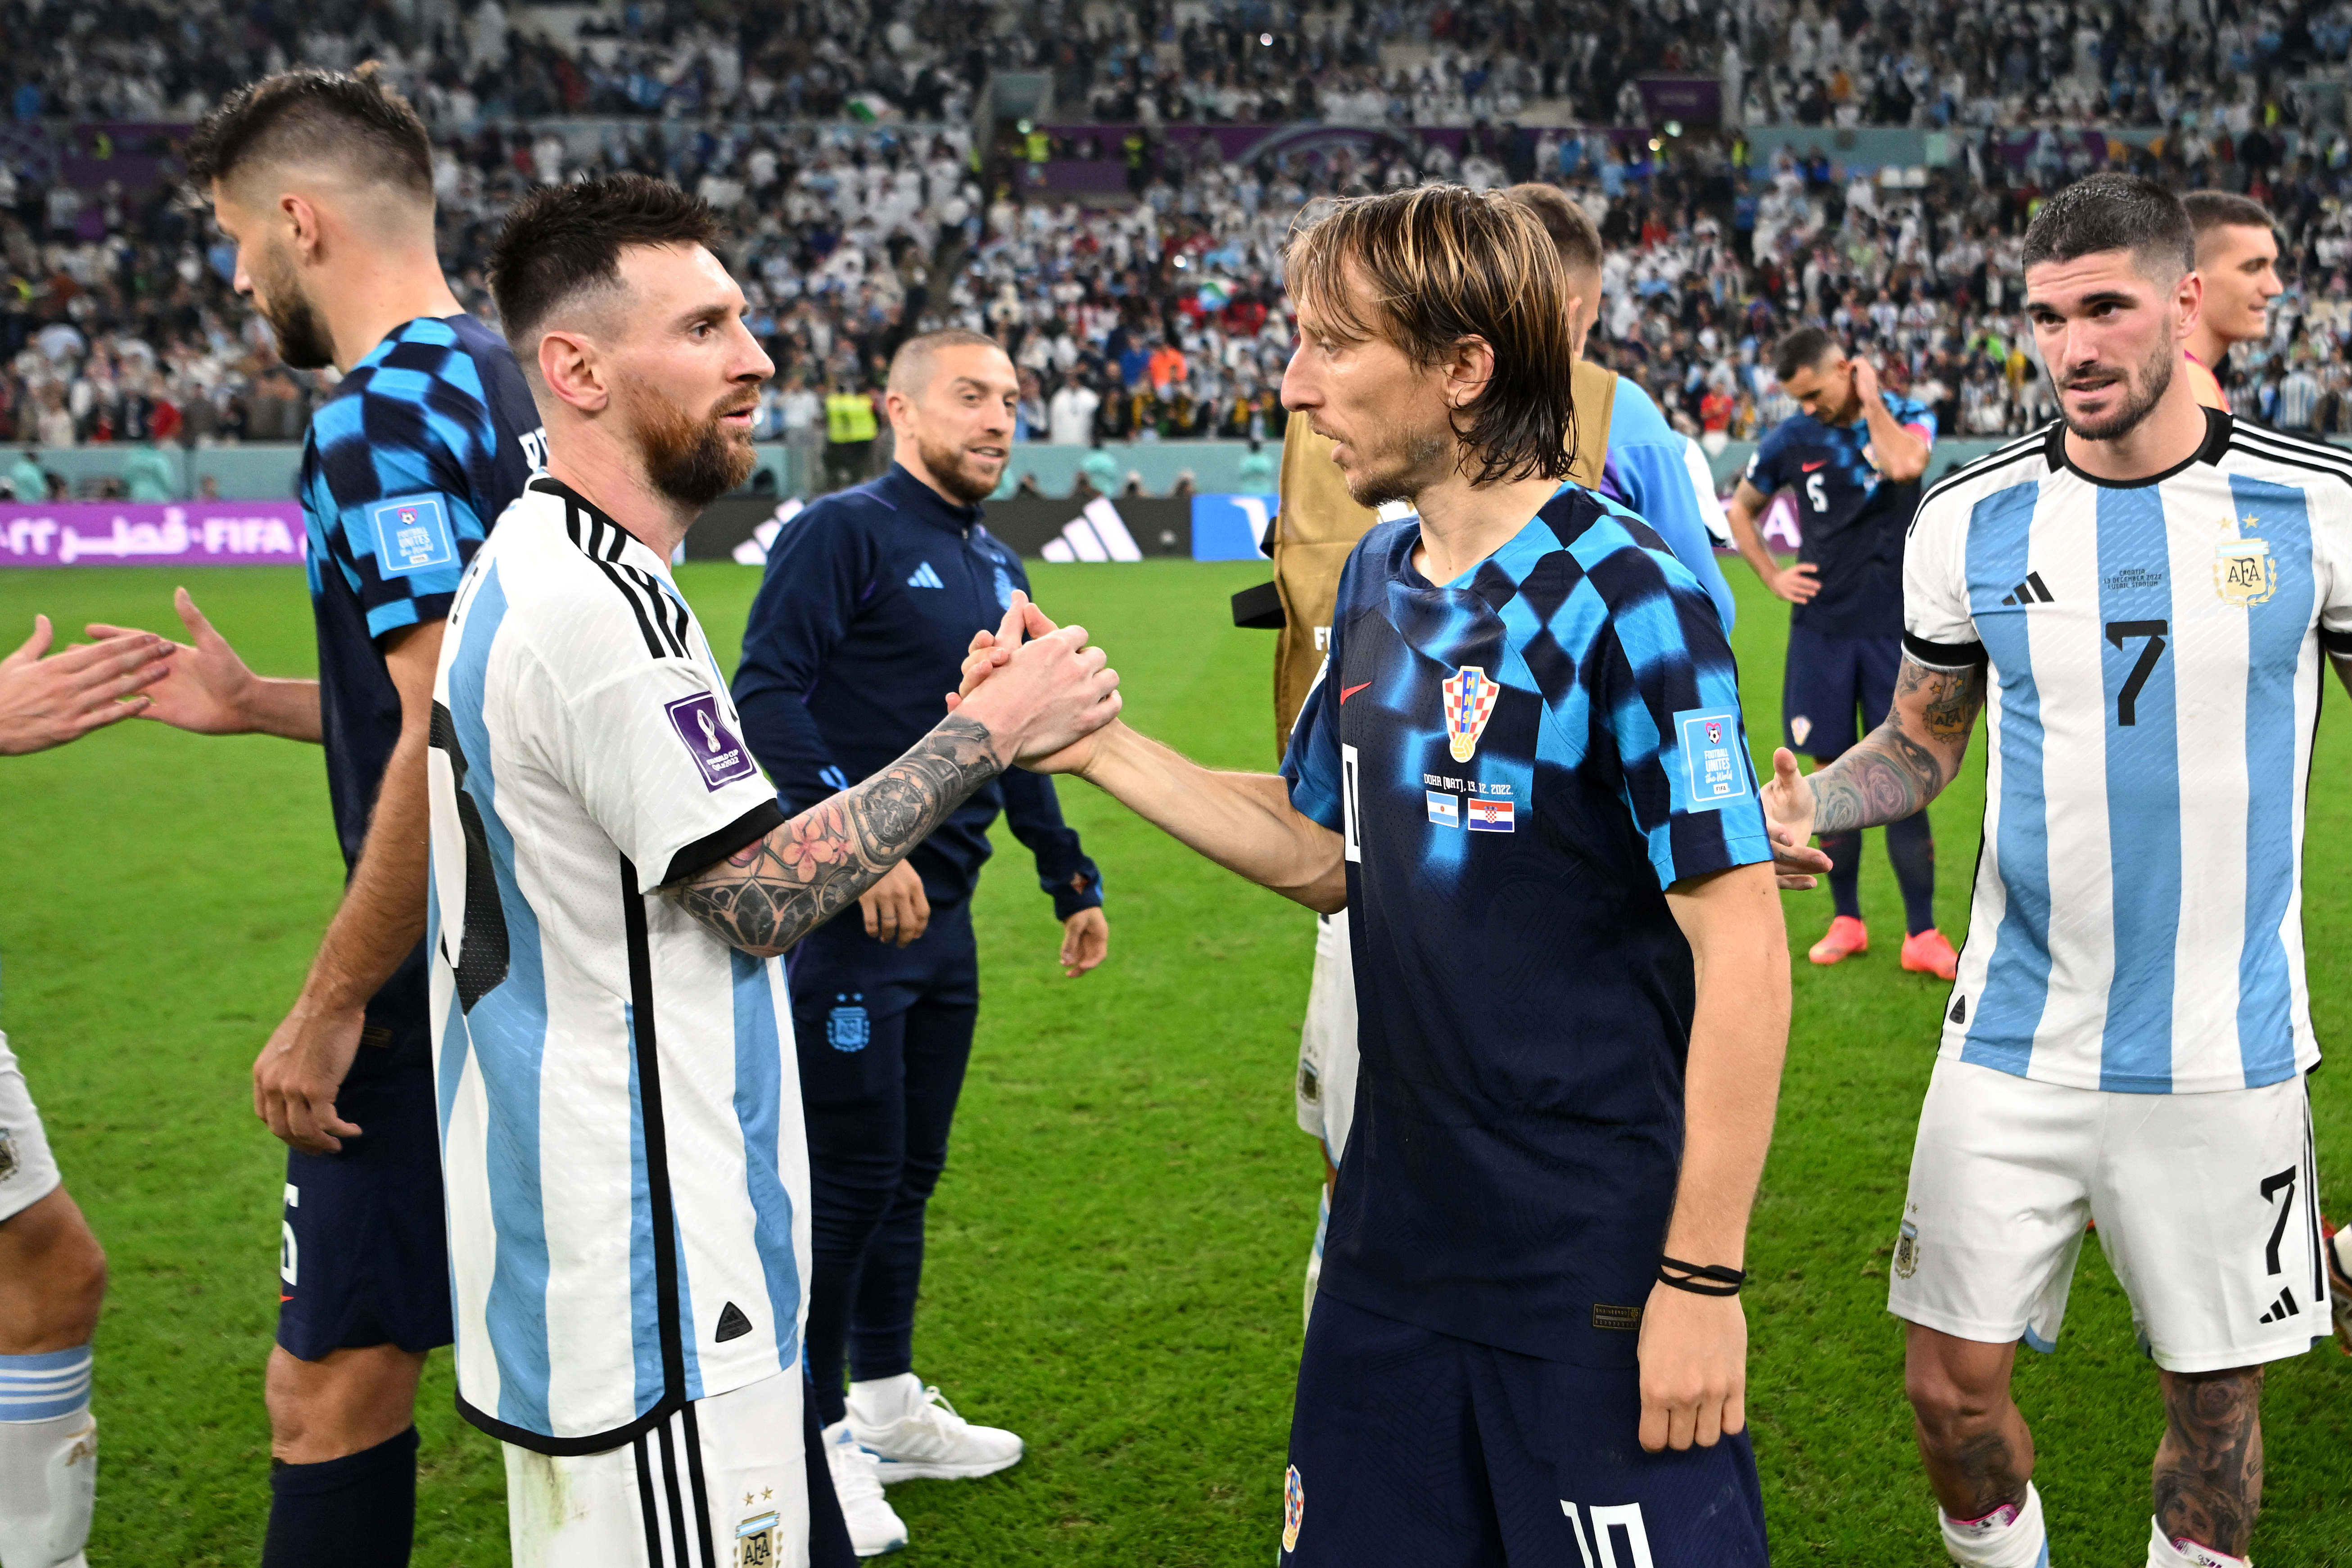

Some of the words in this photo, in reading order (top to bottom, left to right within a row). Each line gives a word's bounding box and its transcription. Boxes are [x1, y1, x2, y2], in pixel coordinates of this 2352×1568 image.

[58, 506, 188, 565] قطر
[203, 517, 294, 554] FIFA
[2112, 575, 2144, 583] DECEMBER
[2227, 557, 2261, 587] AFA
[2105, 619, 2168, 726] 7
[728, 749, 739, 758] CUP
[1704, 748, 1729, 760] FOOTBALL
[1705, 758, 1730, 772] UNITES
[1423, 773, 1442, 787] DOHA
[1467, 781, 1477, 792] 13.
[1479, 783, 1489, 794] 12.
[1491, 784, 1514, 795] 2022.
[1705, 773, 1716, 784] the
[1716, 770, 1732, 782] World
[2260, 1165, 2296, 1276] 7
[743, 1531, 771, 1566] AFA
